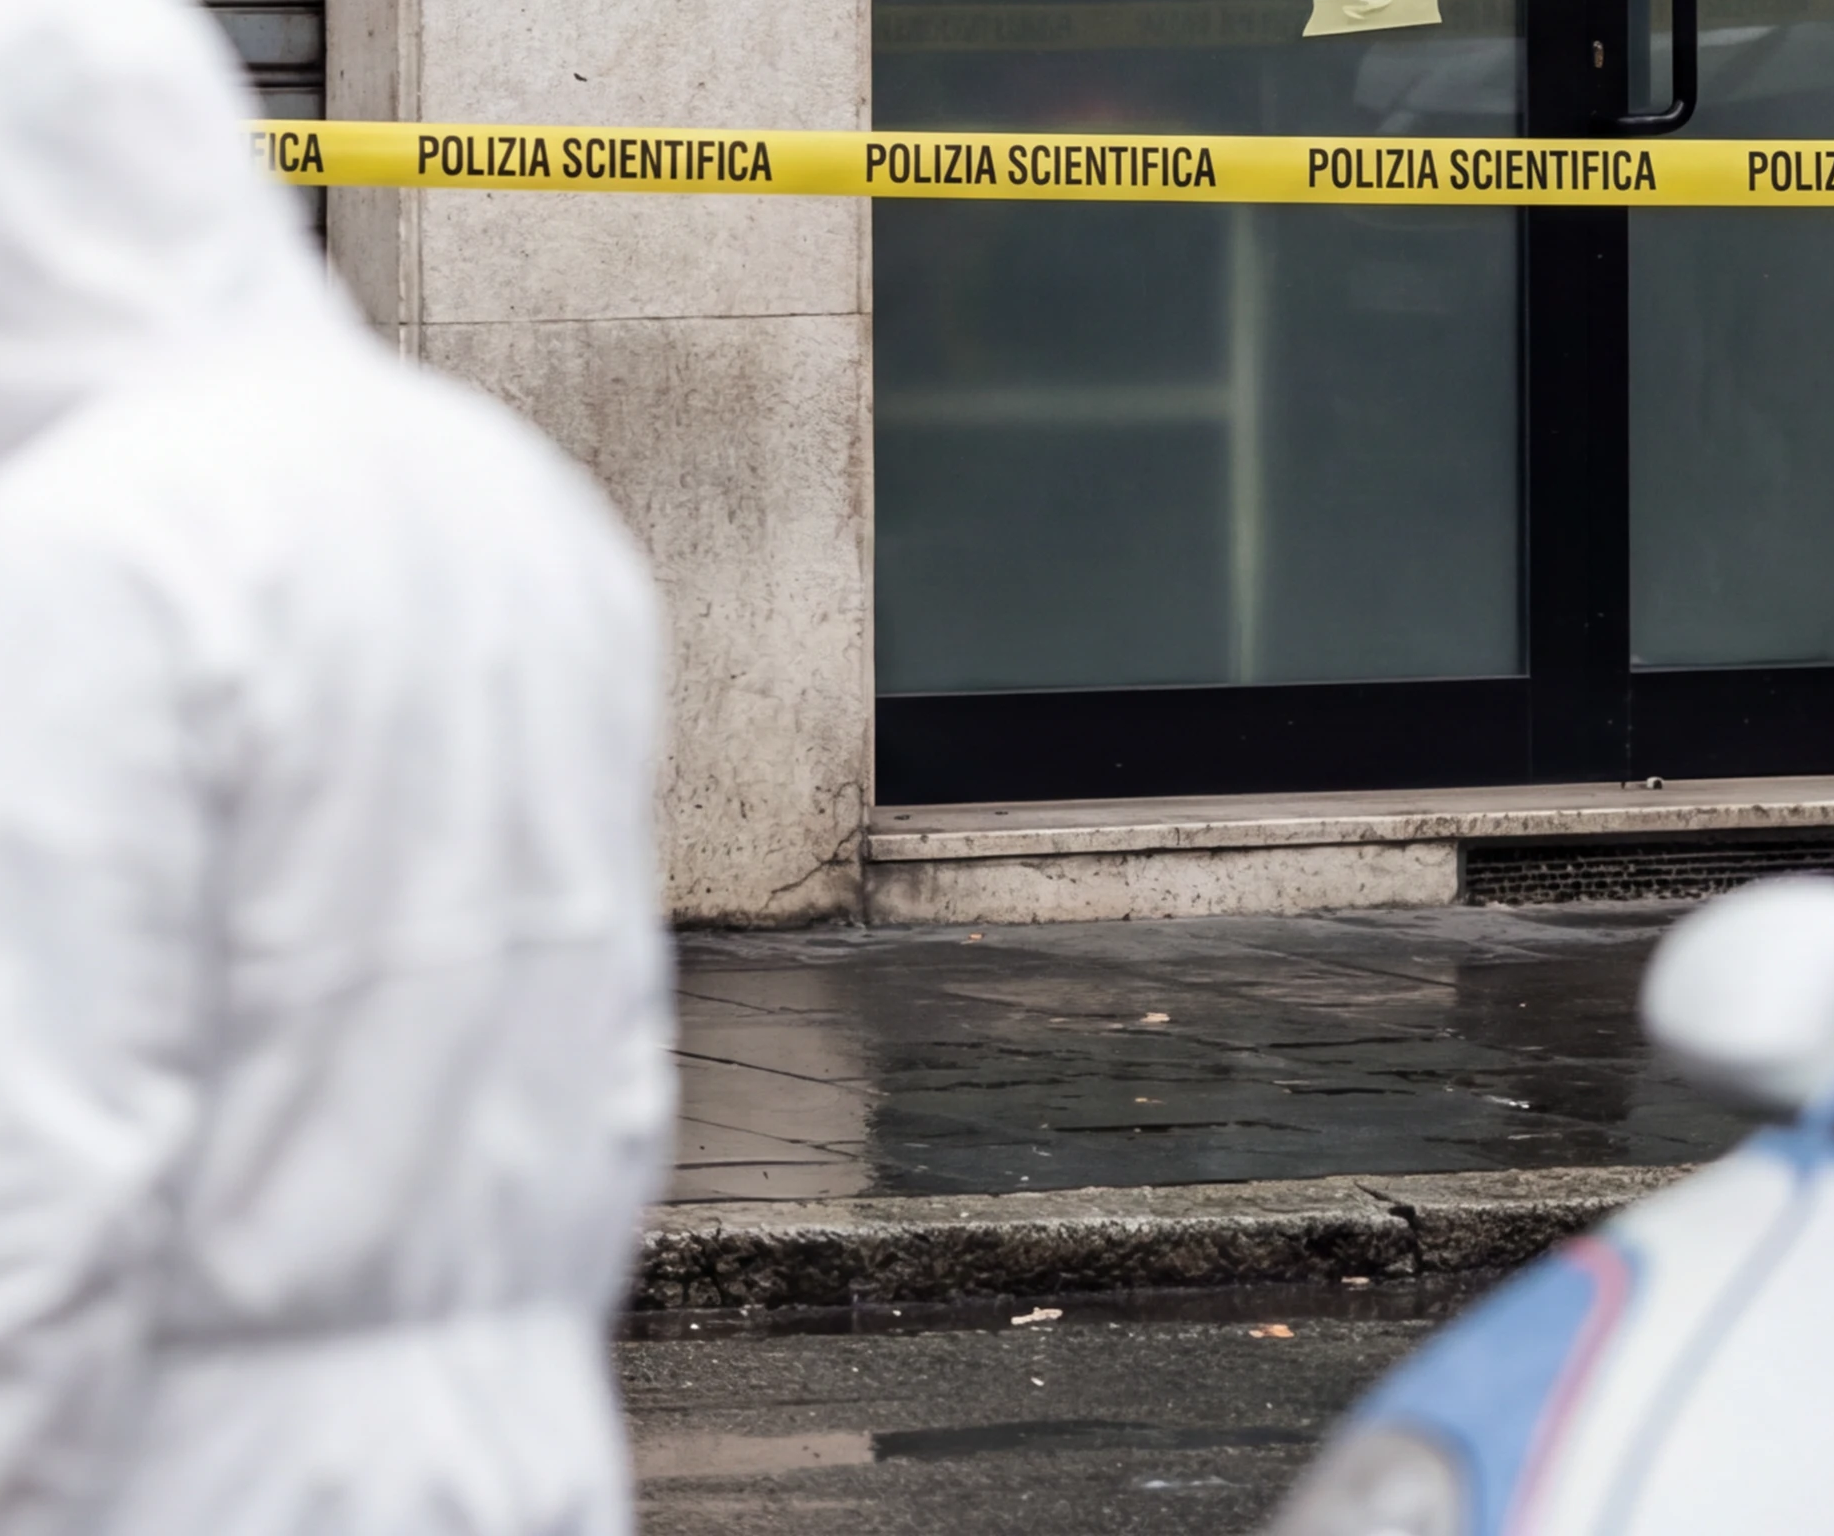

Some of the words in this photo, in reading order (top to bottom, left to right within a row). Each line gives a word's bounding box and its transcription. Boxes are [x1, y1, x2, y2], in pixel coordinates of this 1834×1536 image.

[418, 135, 551, 177] POLIZIA
[563, 138, 772, 182] SCIENTIFICA
[866, 143, 997, 185] POLIZIA
[1008, 145, 1216, 188] SCIENTIFICA
[1309, 147, 1439, 189] POLIZIA
[1450, 149, 1656, 191] SCIENTIFICA
